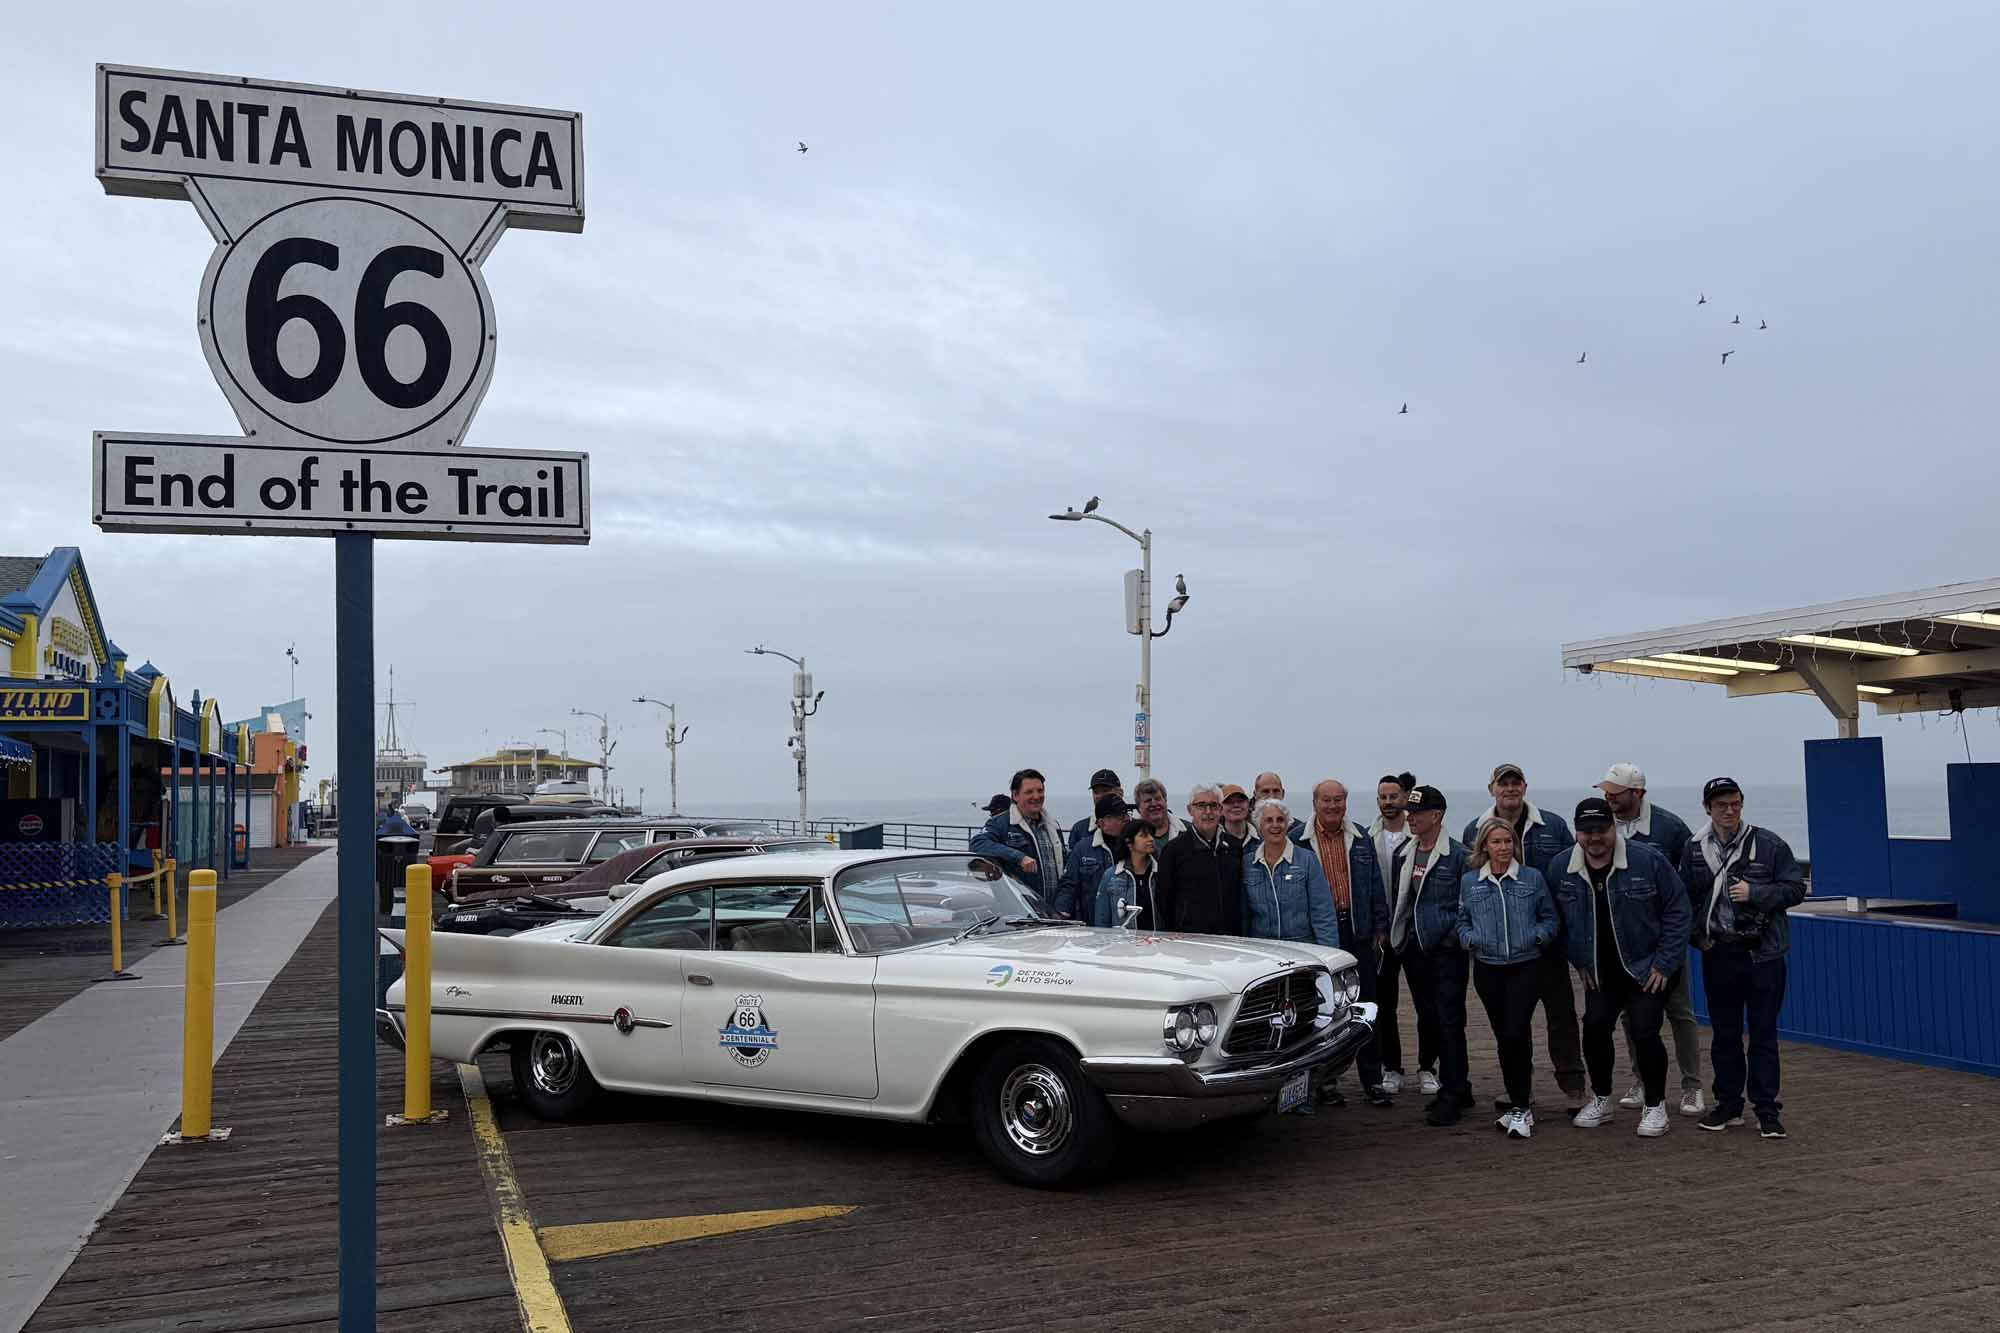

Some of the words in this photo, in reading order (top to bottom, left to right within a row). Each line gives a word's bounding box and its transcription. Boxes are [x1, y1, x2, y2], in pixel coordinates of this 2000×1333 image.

[118, 89, 312, 169] SANTA
[335, 113, 563, 191] MONICA
[245, 236, 452, 409] 66
[123, 453, 236, 509] End
[259, 456, 320, 511] of
[339, 458, 428, 515] the
[447, 465, 566, 519] Trail
[1017, 969, 1061, 977] DETROIT
[1014, 976, 1042, 984] AUTO
[1043, 977, 1074, 985] SHOW
[551, 994, 584, 1006] HAGERTY
[738, 998, 758, 1006] ROUTE
[739, 1011, 755, 1027] 66
[726, 1035, 769, 1043] CENTENNIAL
[730, 1047, 767, 1066] CERTIFIED
